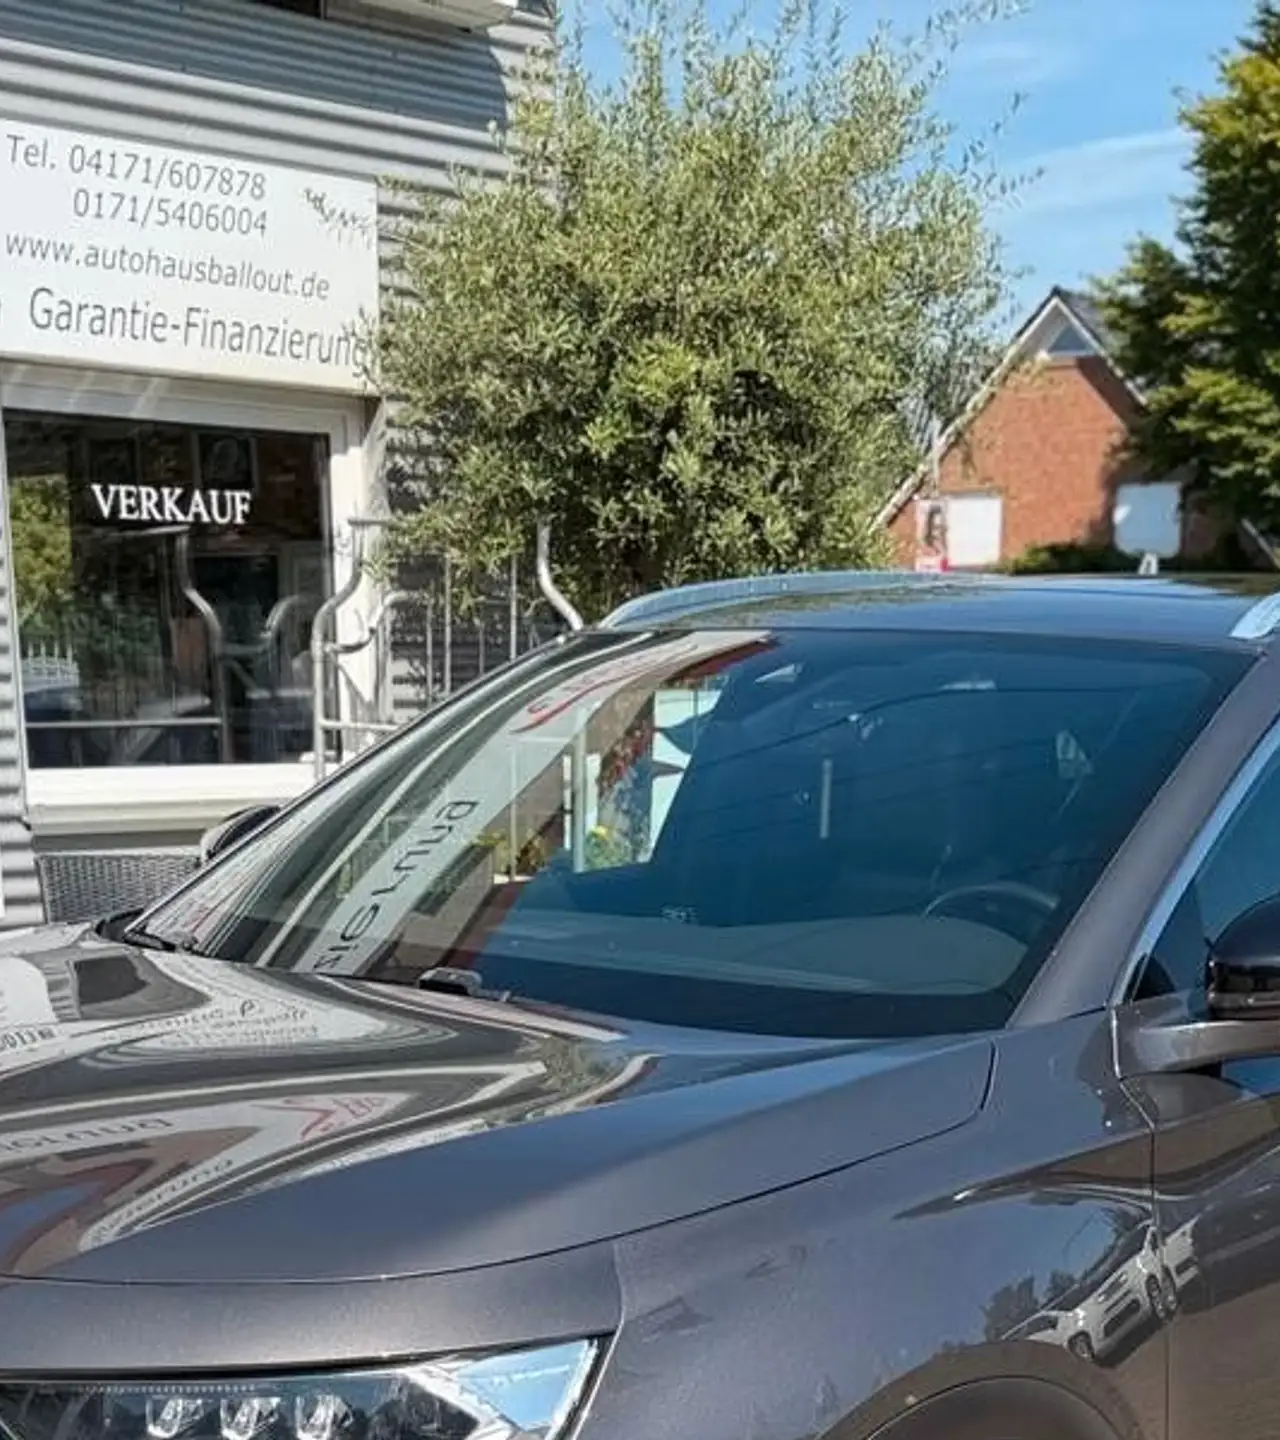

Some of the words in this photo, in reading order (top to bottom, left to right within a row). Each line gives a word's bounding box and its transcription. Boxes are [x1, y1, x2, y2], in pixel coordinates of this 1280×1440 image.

[6, 134, 56, 170] Tel.
[69, 144, 266, 200] 04171/607878
[73, 188, 267, 237] 0171/5406004
[6, 233, 330, 301] www.autohausballout.de
[29, 287, 372, 378] Garantie-Finanzierung
[90, 484, 252, 525] VERKAUF
